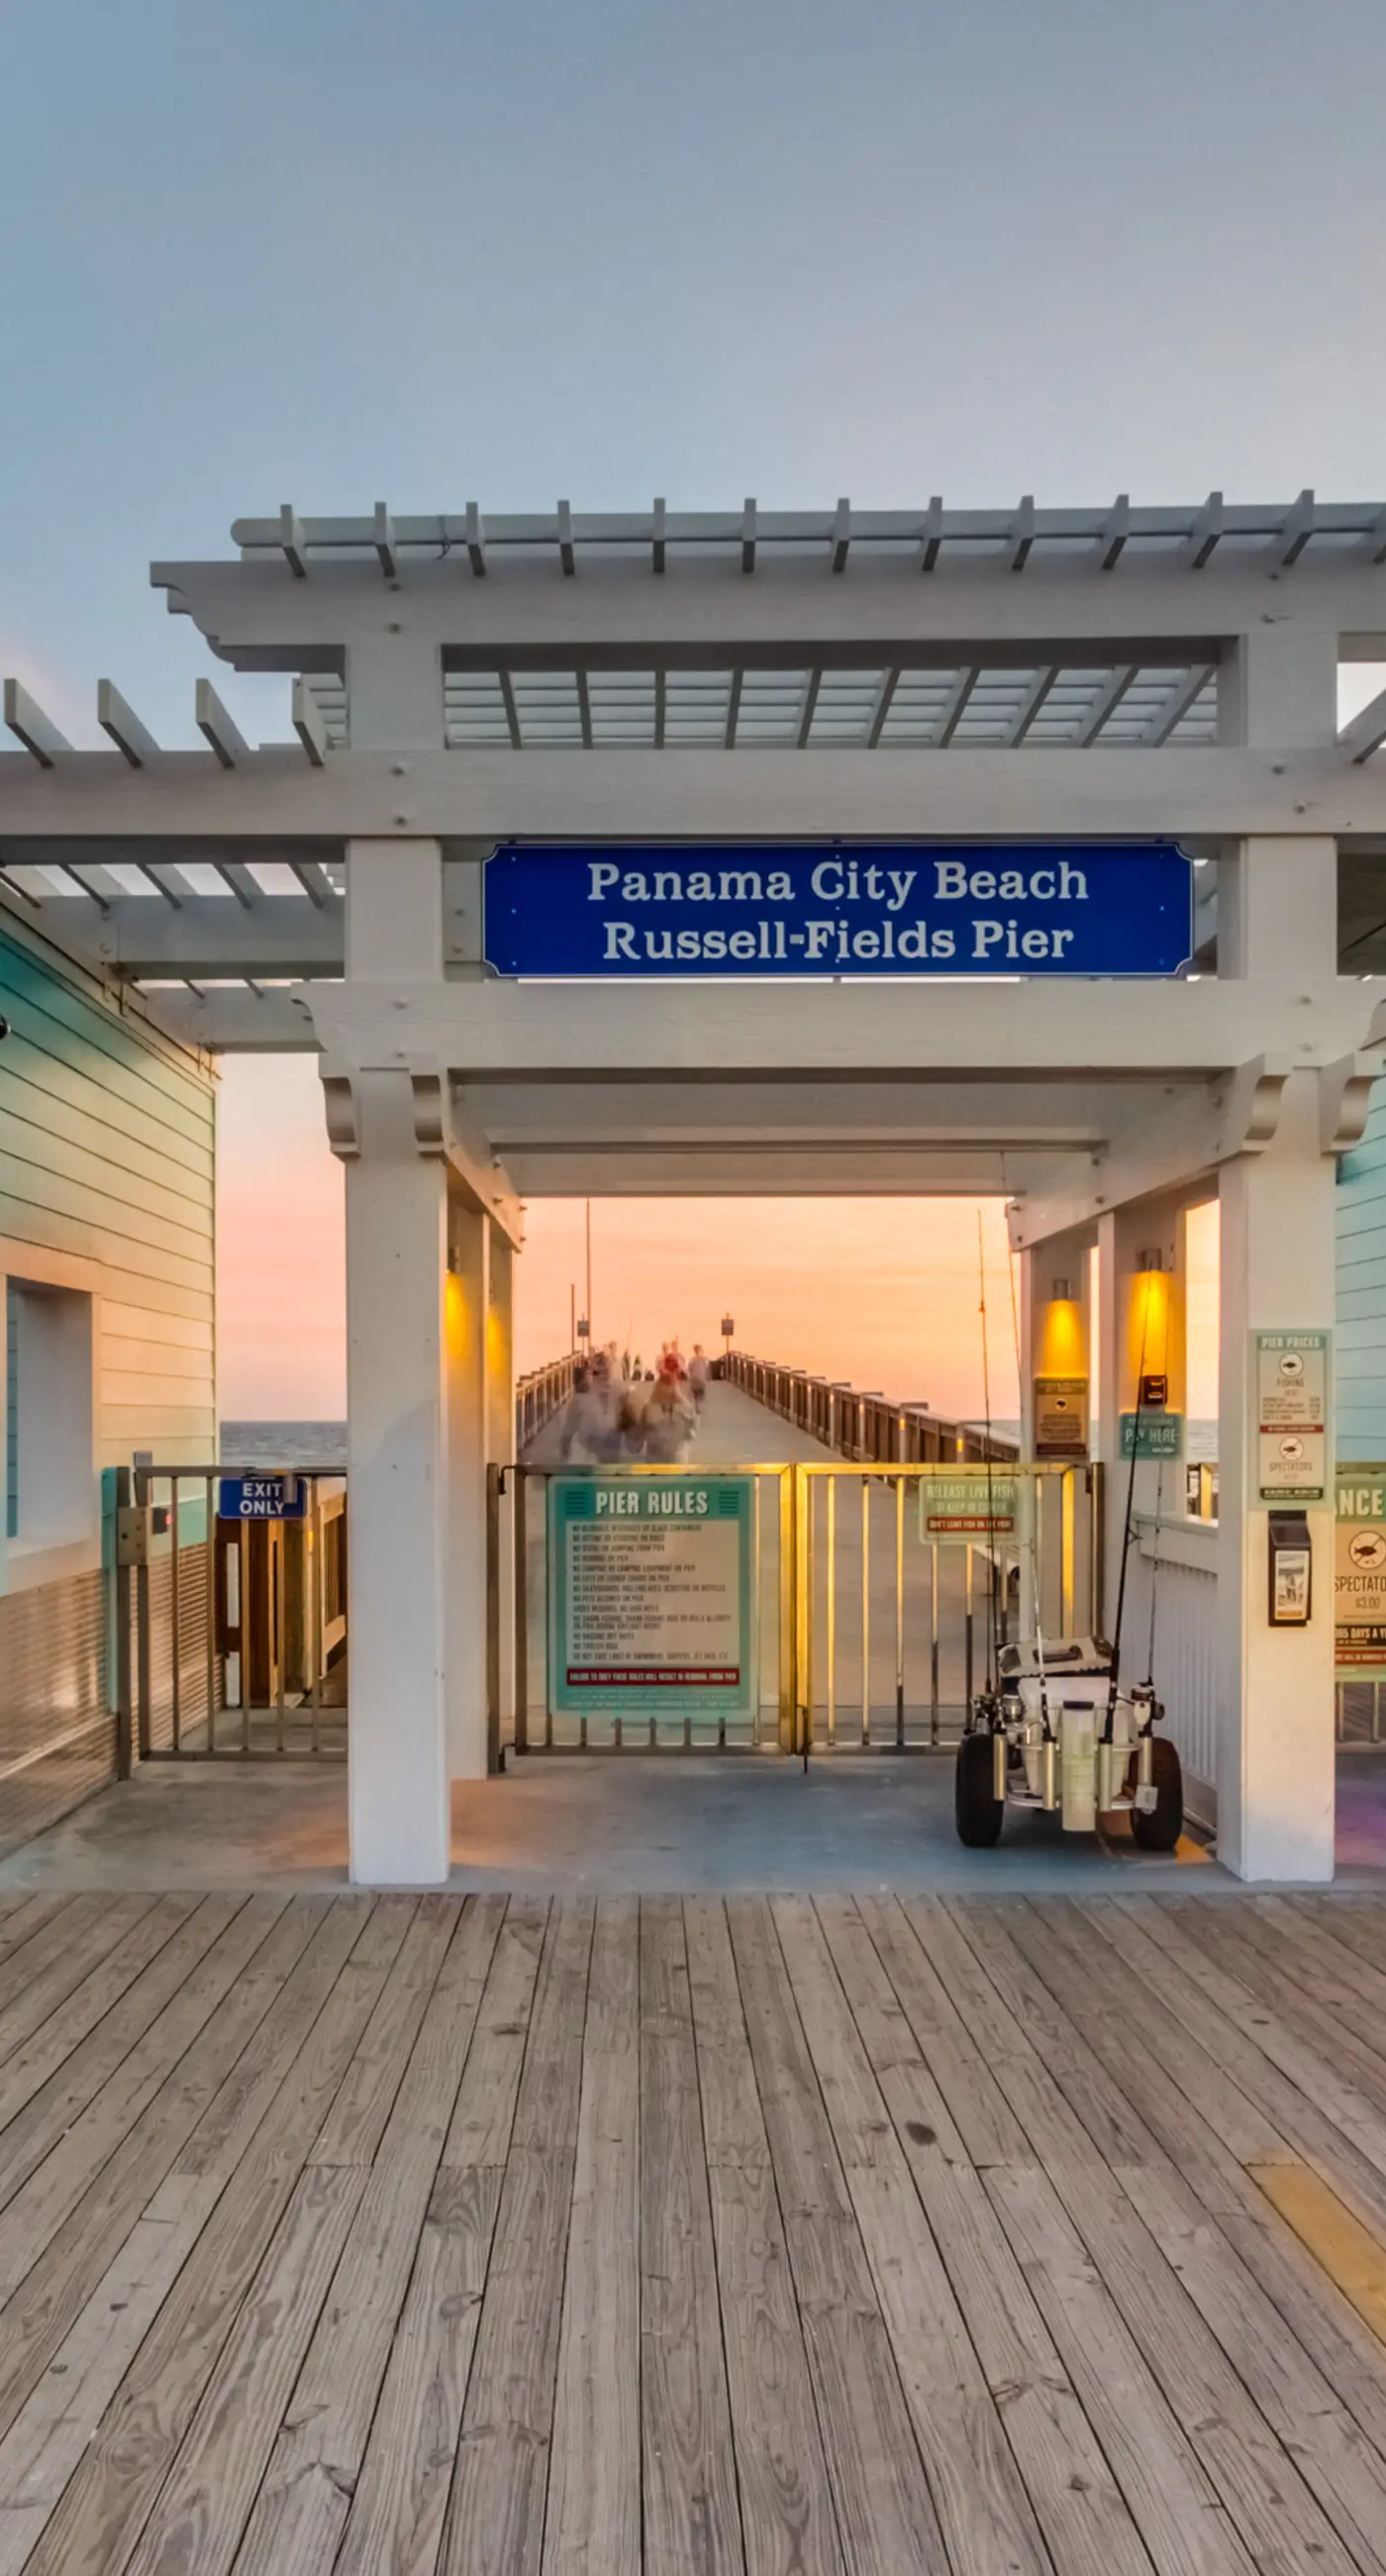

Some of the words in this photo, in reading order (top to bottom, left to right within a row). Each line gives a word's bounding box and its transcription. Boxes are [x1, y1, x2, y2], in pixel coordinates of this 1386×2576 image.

[587, 861, 795, 901] Panama
[811, 861, 918, 909] City
[934, 861, 1089, 899] Beach
[603, 920, 955, 960] Russell-Fields
[971, 921, 1074, 959] Pier
[1261, 1336, 1283, 1347] PIER
[1287, 1336, 1320, 1347] PRICES
[1125, 1429, 1145, 1442] PY
[1149, 1429, 1175, 1443] HERE
[243, 1482, 282, 1497] EXIT
[240, 1500, 284, 1515] ONLY
[596, 1492, 640, 1514] PIER
[647, 1492, 708, 1514] RULES
[1336, 1489, 1383, 1516] NCE
[1335, 1576, 1386, 1592] SPECTATO
[1355, 1597, 1381, 1609] $3.00
[1350, 1628, 1370, 1639] DAYS
[1372, 1628, 1378, 1639] A
